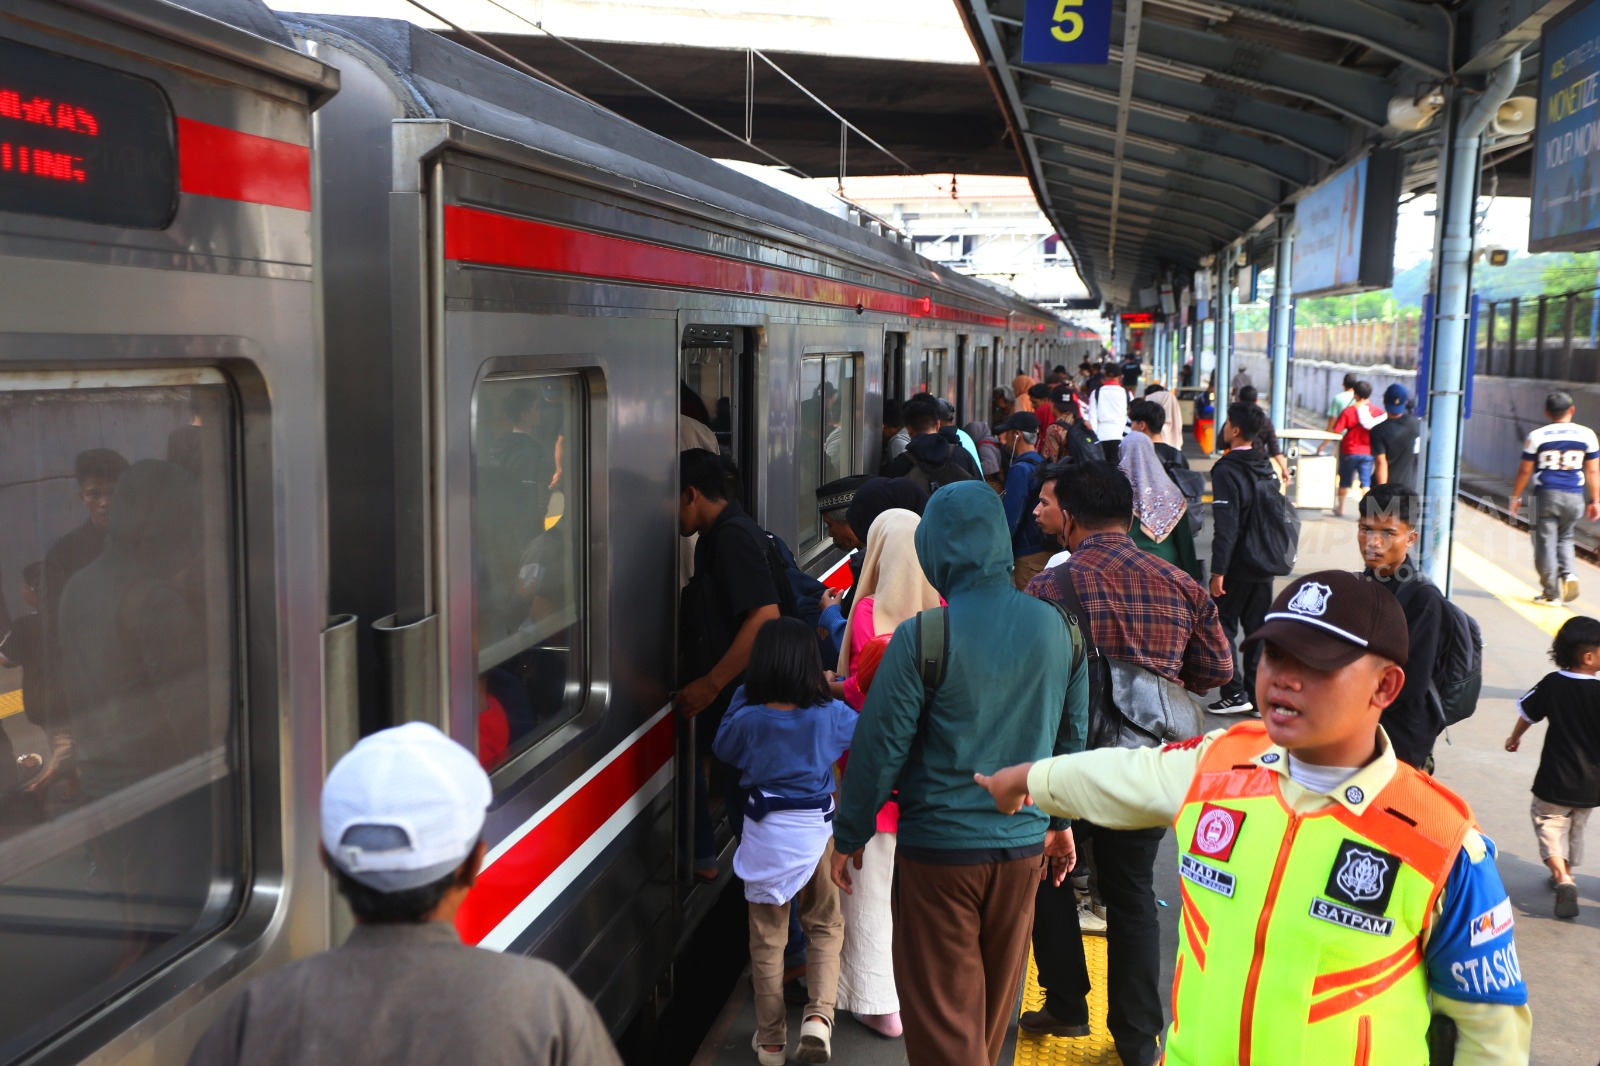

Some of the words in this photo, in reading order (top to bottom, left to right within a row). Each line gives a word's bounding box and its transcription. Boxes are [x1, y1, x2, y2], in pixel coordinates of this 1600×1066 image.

[1050, 0, 1084, 42] 5
[1190, 861, 1220, 882] HADI
[1317, 903, 1388, 933] SATPAM
[1474, 912, 1495, 935] KAI
[1451, 936, 1521, 995] STASIO
